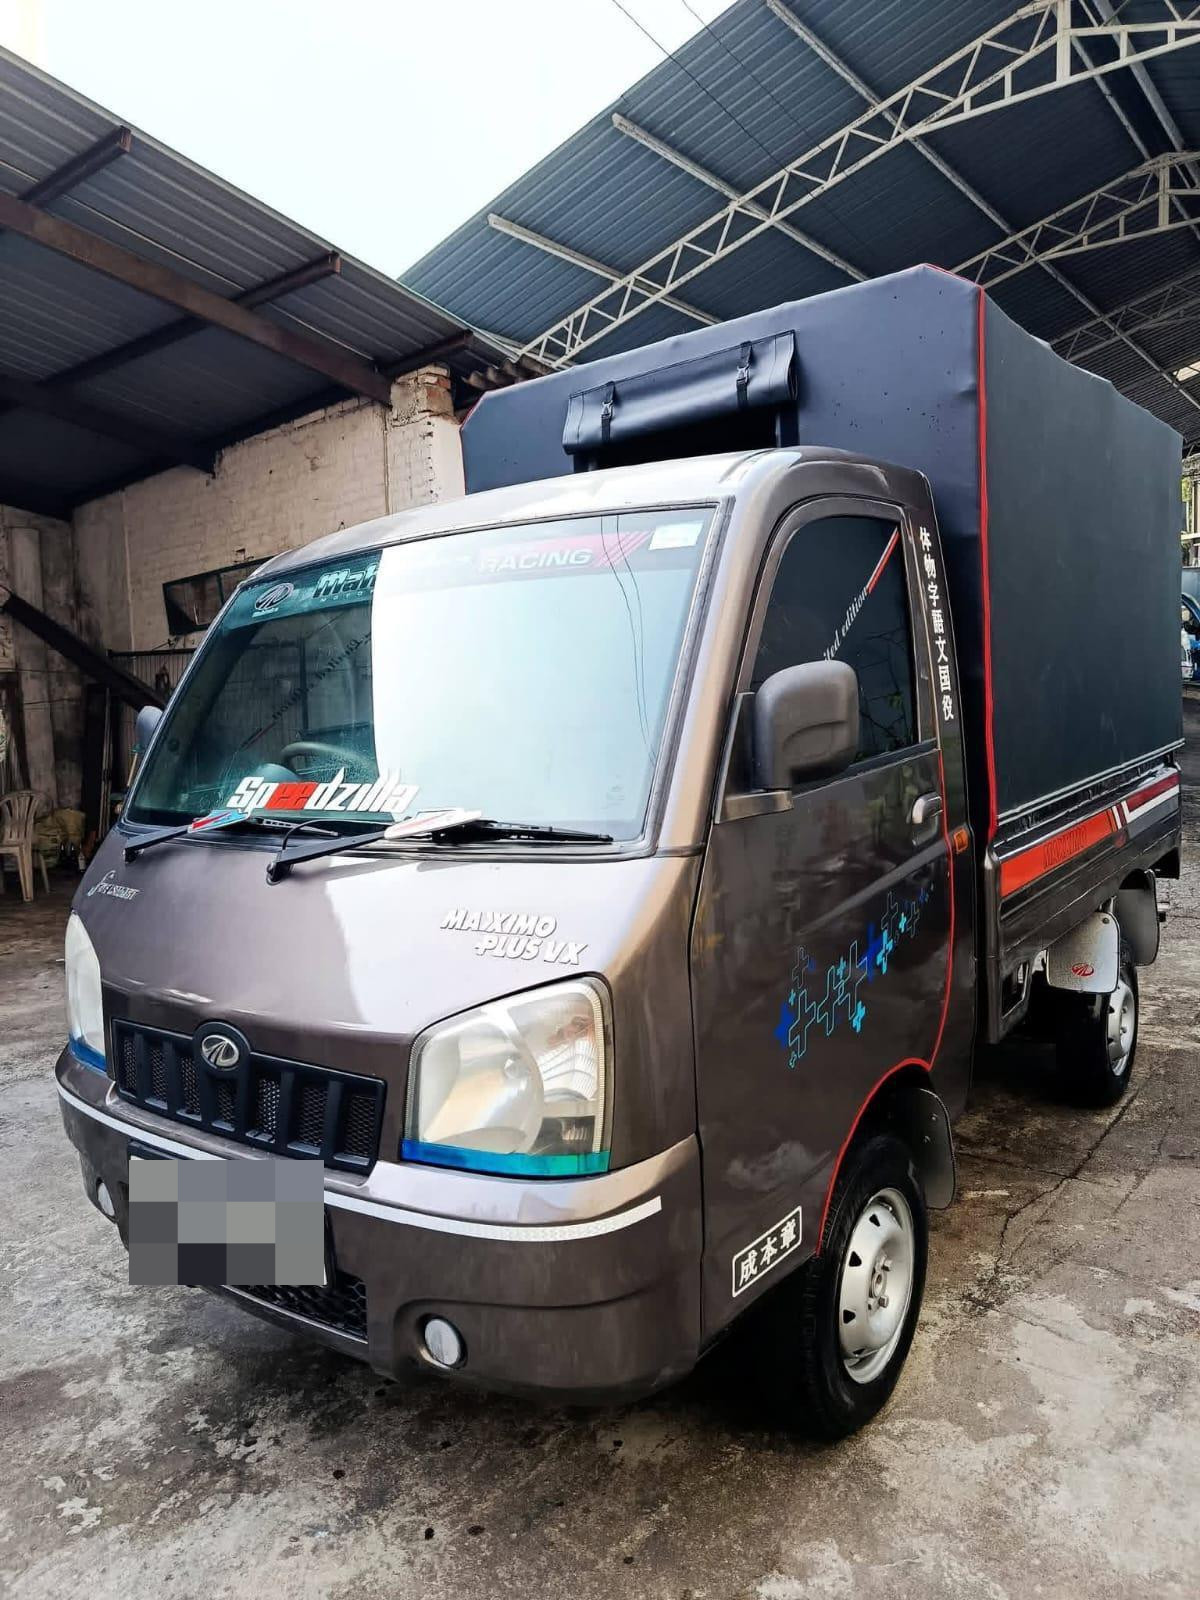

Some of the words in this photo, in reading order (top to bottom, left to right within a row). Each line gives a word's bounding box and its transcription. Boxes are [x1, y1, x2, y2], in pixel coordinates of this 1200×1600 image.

[479, 548, 593, 572] RACING
[226, 767, 420, 815] Speedzilla
[543, 940, 589, 965] VX
